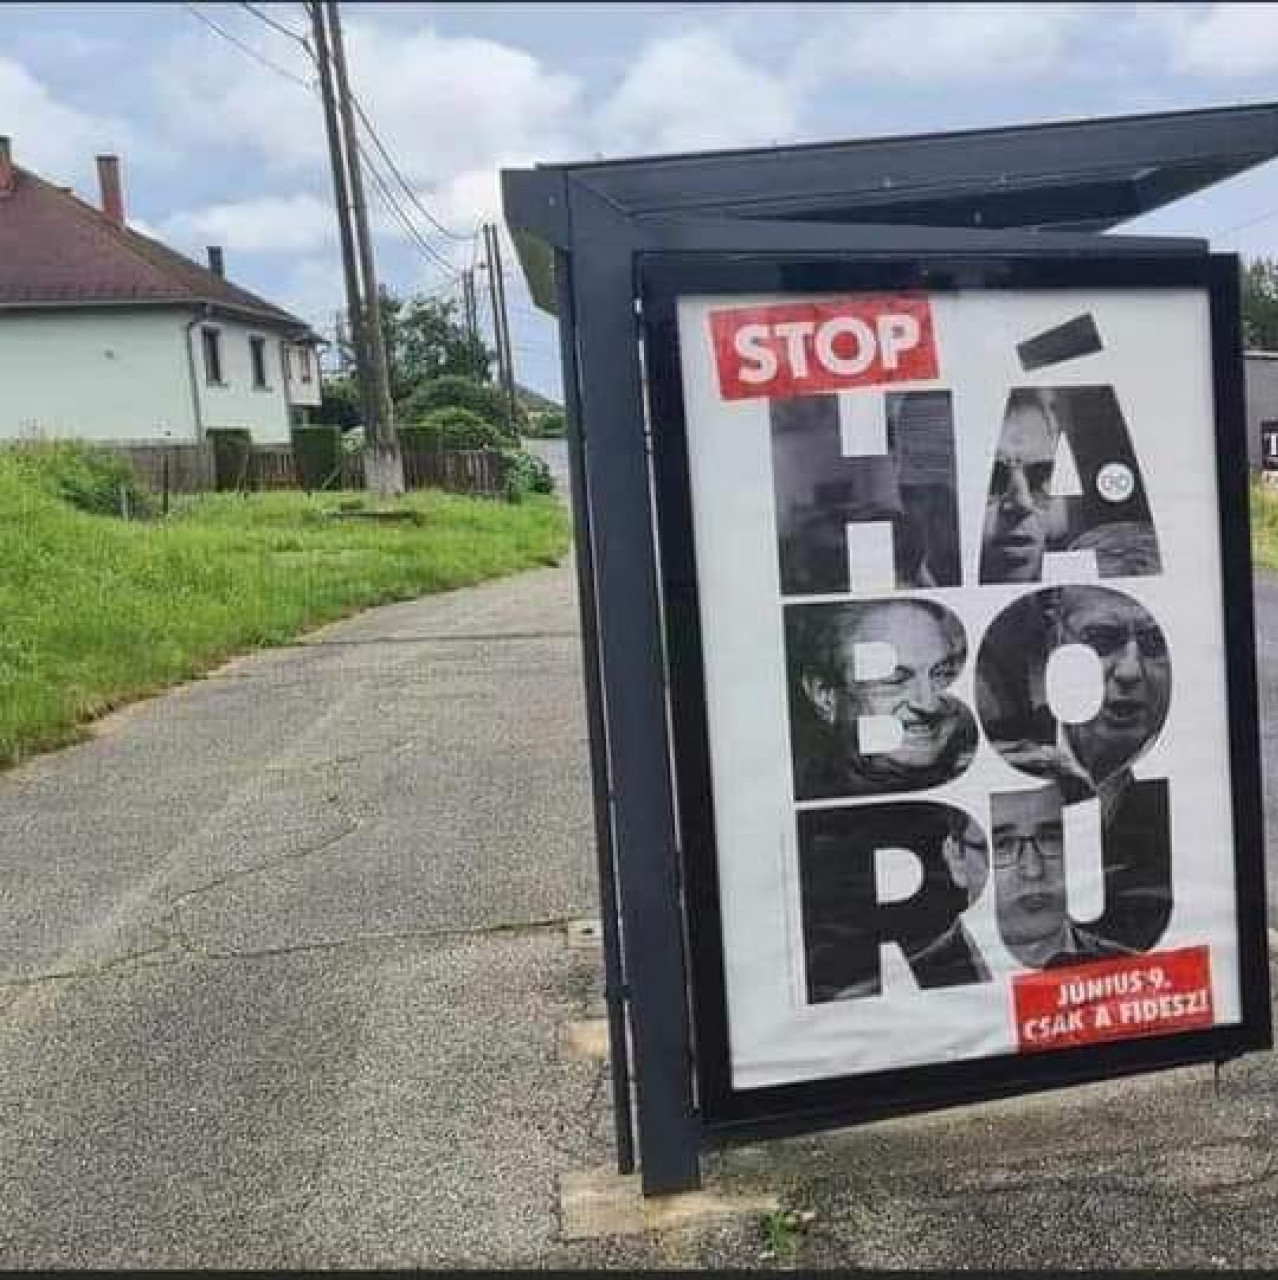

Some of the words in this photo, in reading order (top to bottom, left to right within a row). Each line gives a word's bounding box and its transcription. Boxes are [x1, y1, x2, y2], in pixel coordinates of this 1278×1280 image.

[732, 312, 922, 384] STOP
[769, 312, 1163, 597] HÁ
[784, 584, 1173, 803] BO
[1149, 964, 1174, 990] 9.
[1023, 1008, 1083, 1042] CSAK
[1095, 1004, 1112, 1027] A
